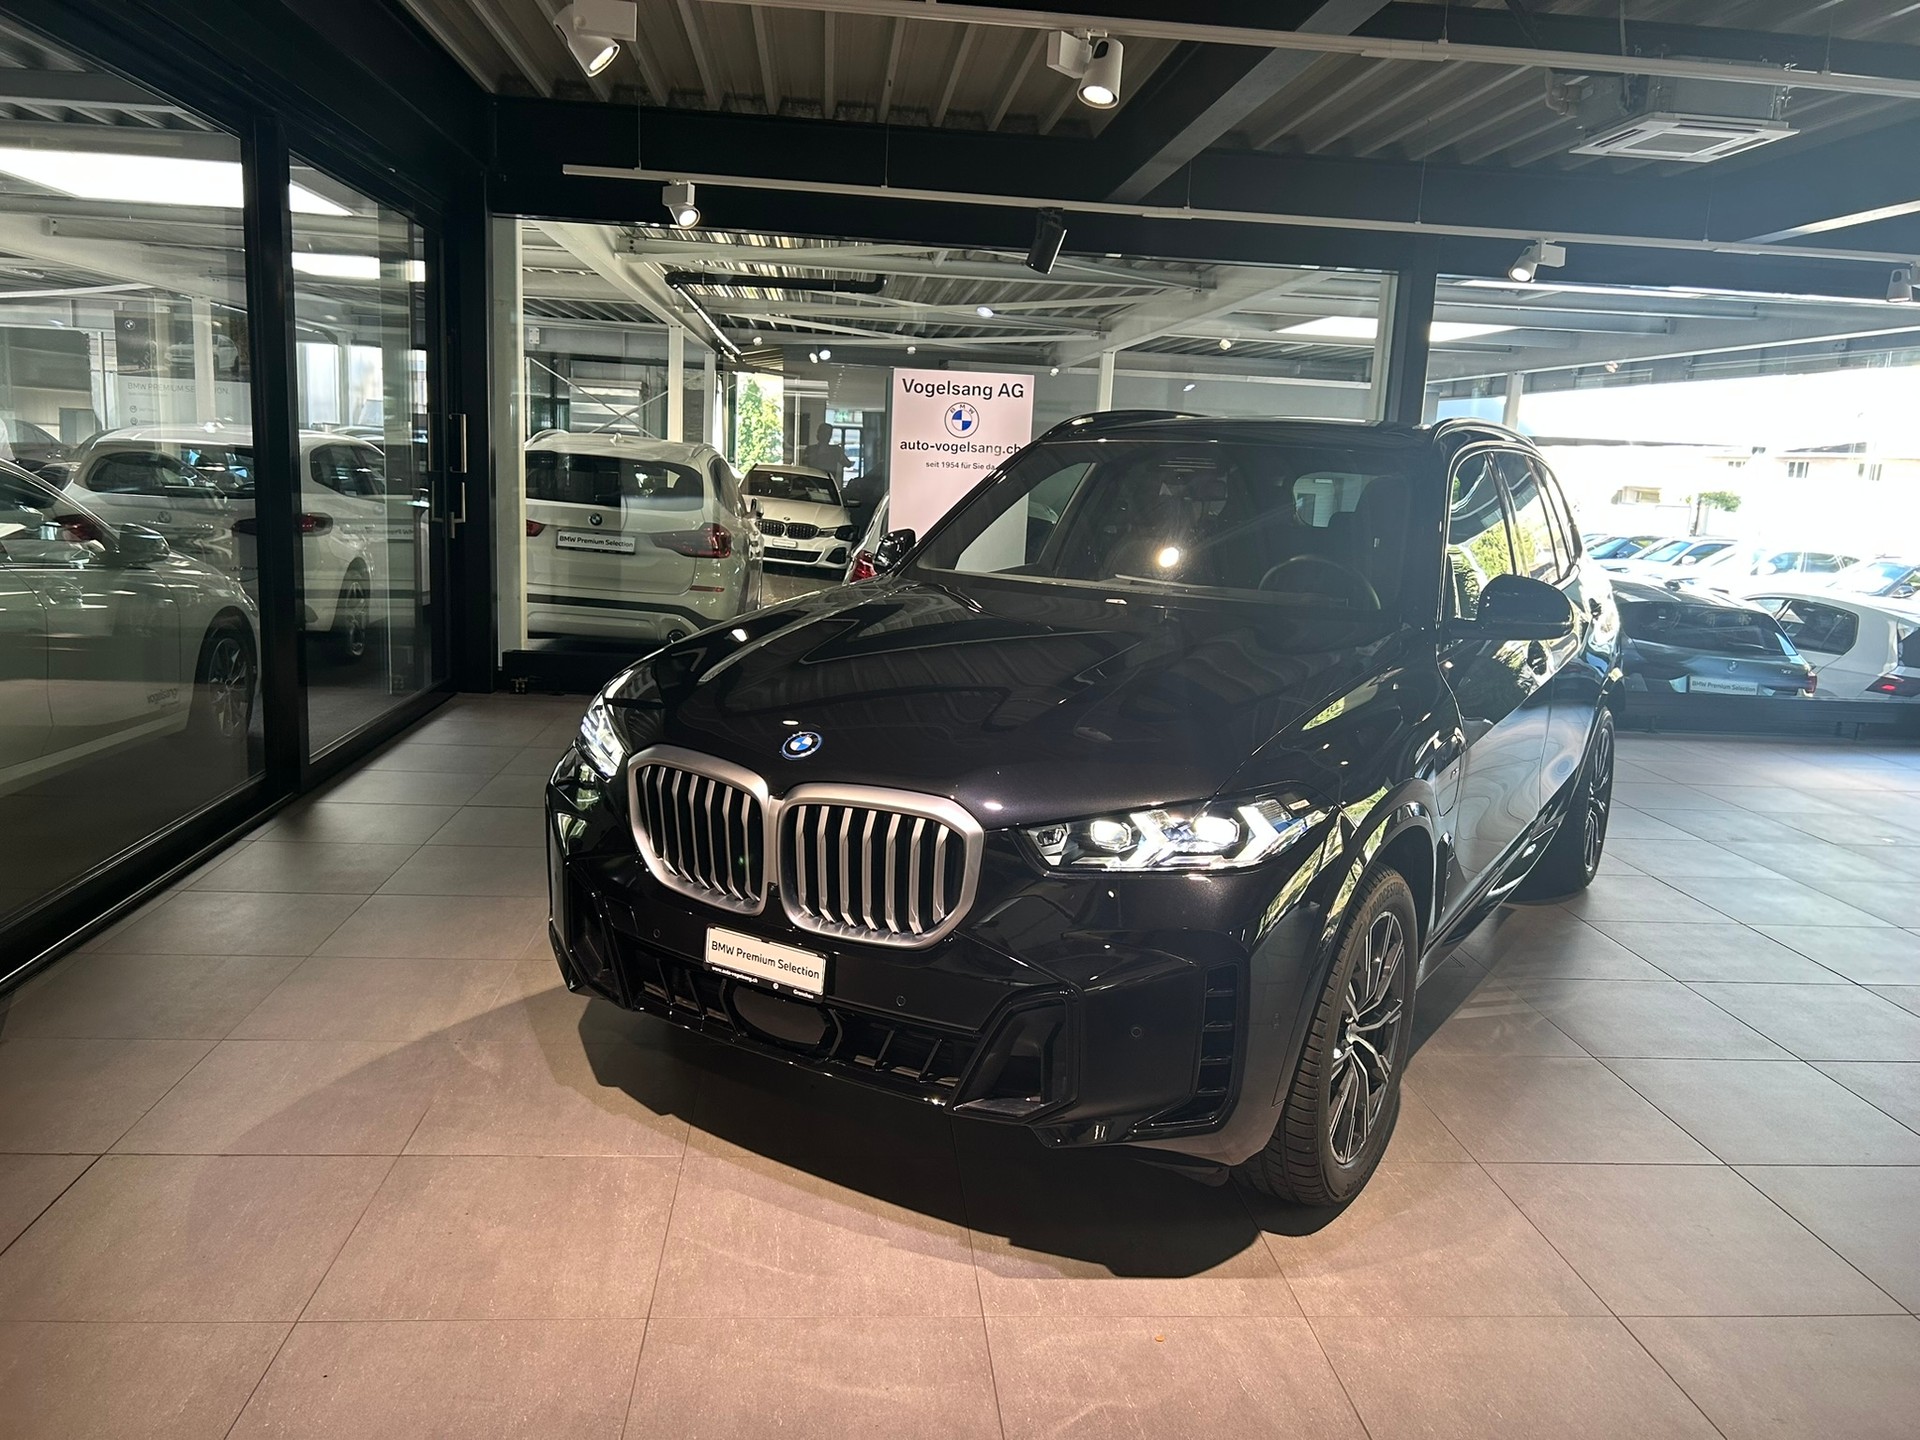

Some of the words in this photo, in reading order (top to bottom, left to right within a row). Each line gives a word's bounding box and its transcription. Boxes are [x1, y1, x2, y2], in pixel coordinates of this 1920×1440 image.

[127, 382, 147, 390] BMW
[185, 385, 229, 394] SEION.
[902, 378, 993, 400] Vogelsang
[997, 383, 1024, 398] AG
[950, 404, 975, 415] BMW
[900, 440, 1021, 456] auto-vogelsang.ch
[941, 461, 959, 469] 1954
[972, 462, 984, 470] Sie
[577, 537, 604, 546] Premium
[605, 540, 634, 548] Selection
[1707, 682, 1731, 690] Premium
[1732, 684, 1756, 692] Selection
[711, 940, 735, 956] BMW
[736, 947, 776, 967] Premium
[777, 959, 820, 979] Selection
